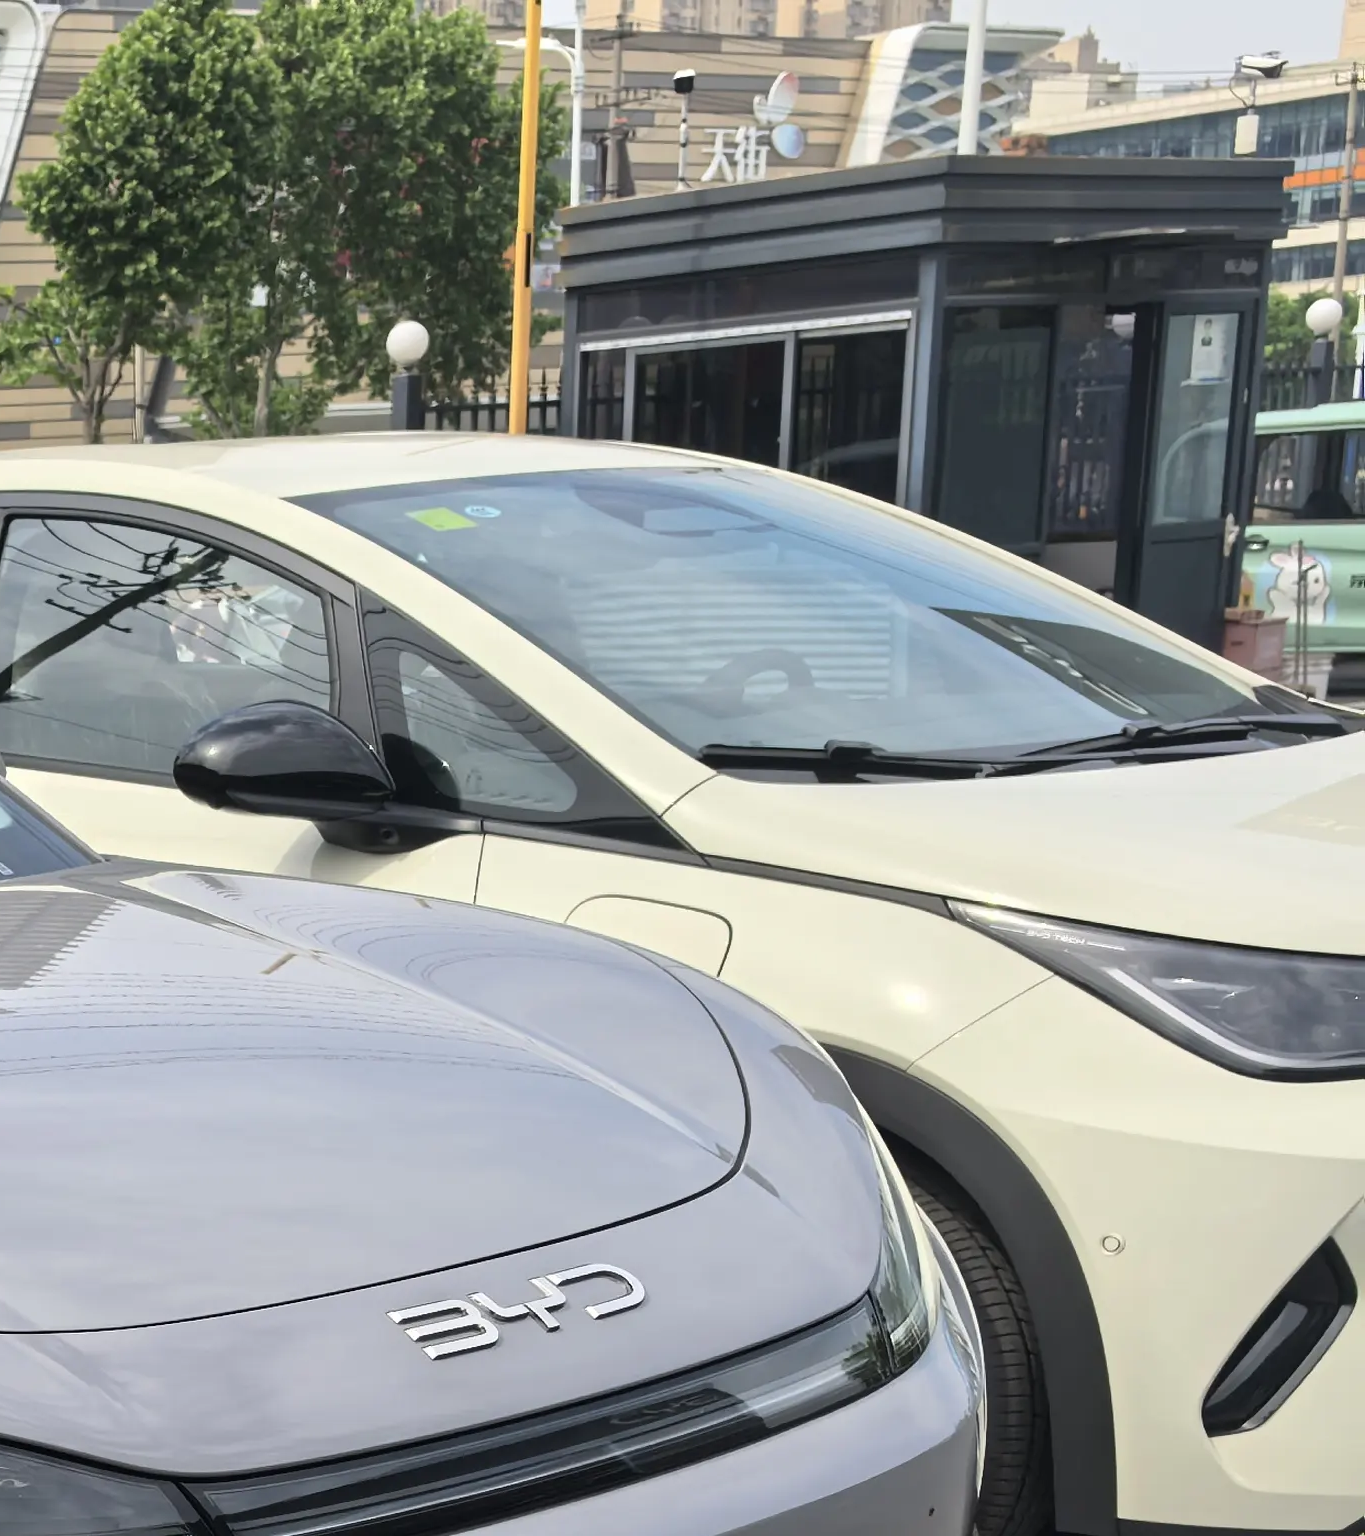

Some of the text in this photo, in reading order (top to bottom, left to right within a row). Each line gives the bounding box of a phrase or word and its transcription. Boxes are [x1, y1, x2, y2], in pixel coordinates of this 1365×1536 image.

[700, 125, 771, 184] 天街
[1026, 929, 1051, 939] BYD
[387, 1262, 647, 1361] BYD
